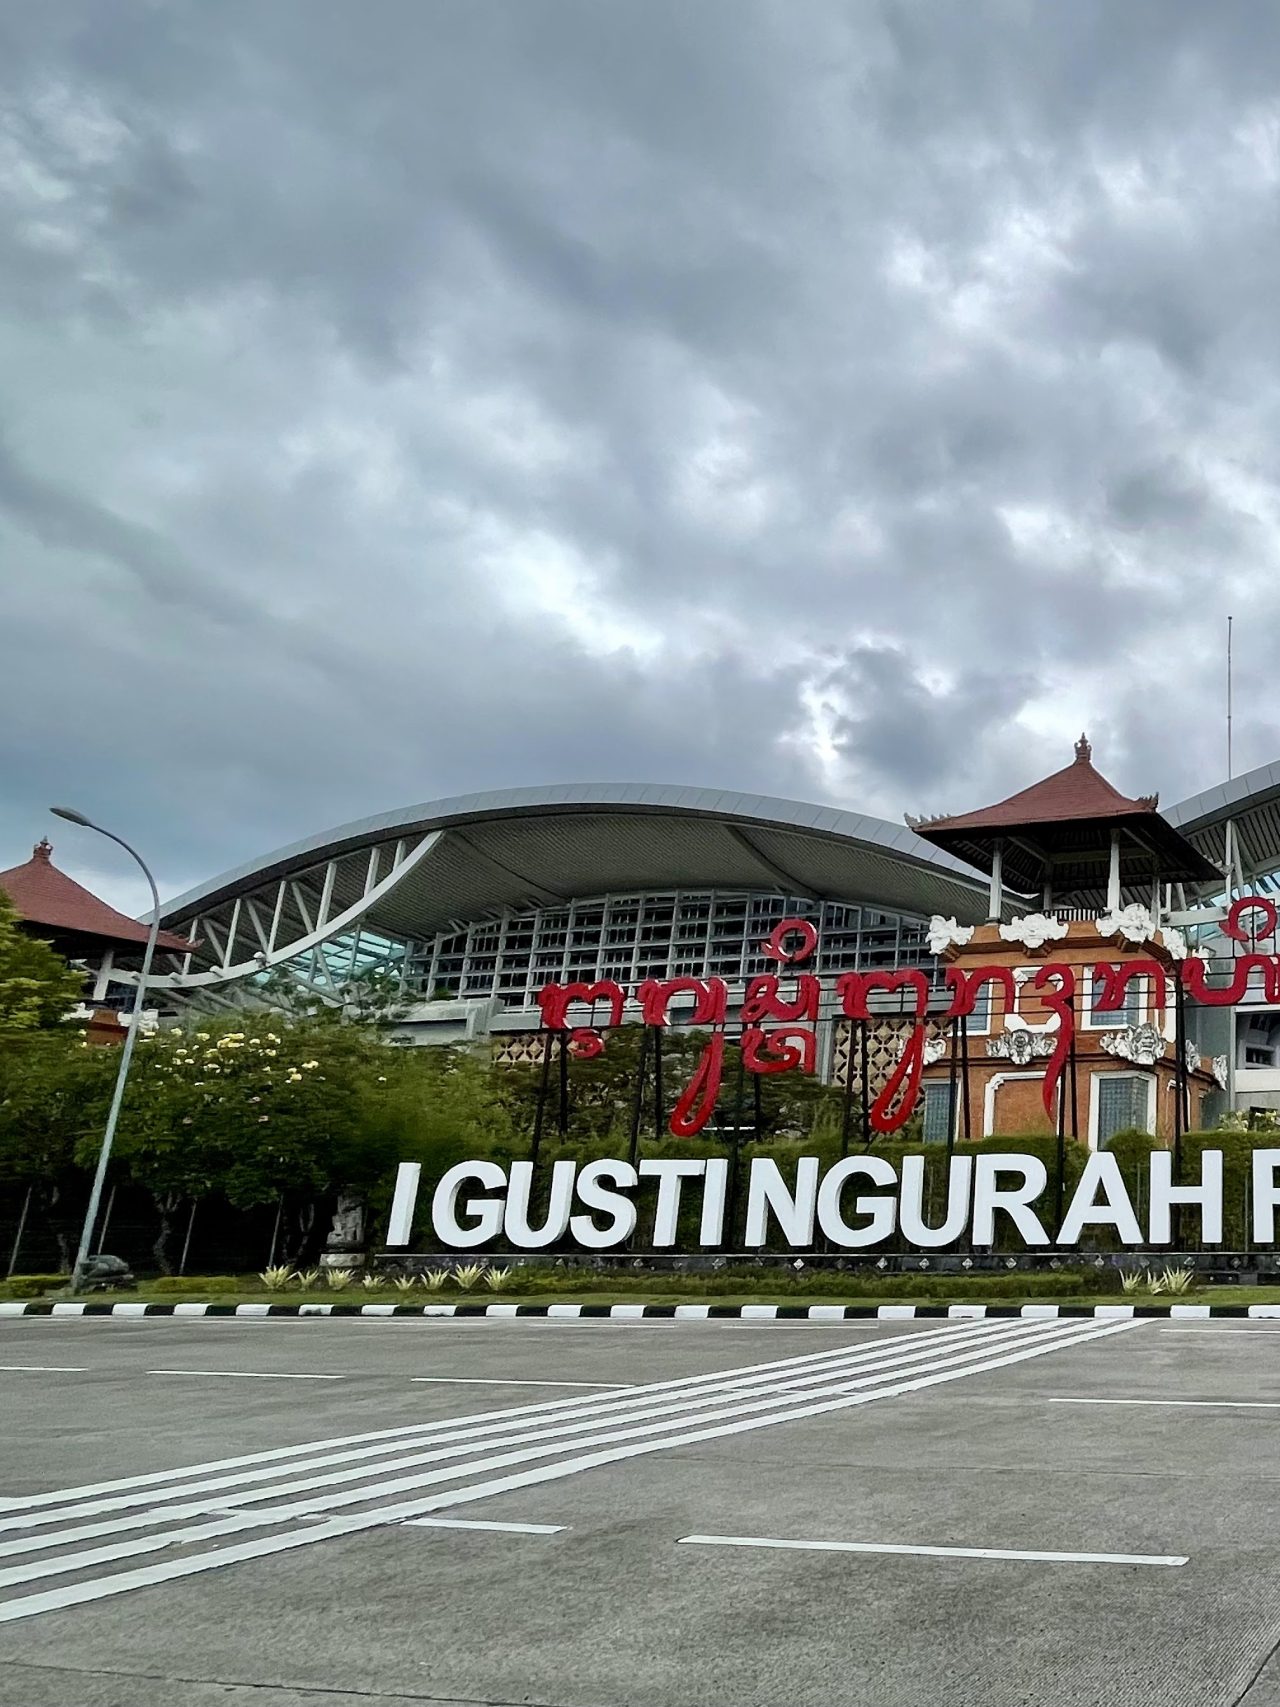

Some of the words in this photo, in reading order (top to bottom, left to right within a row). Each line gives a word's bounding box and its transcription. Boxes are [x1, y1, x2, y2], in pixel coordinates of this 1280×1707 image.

[385, 1162, 421, 1246] I
[431, 1158, 729, 1248] GUSTI
[744, 1149, 1223, 1248] NGURAH
